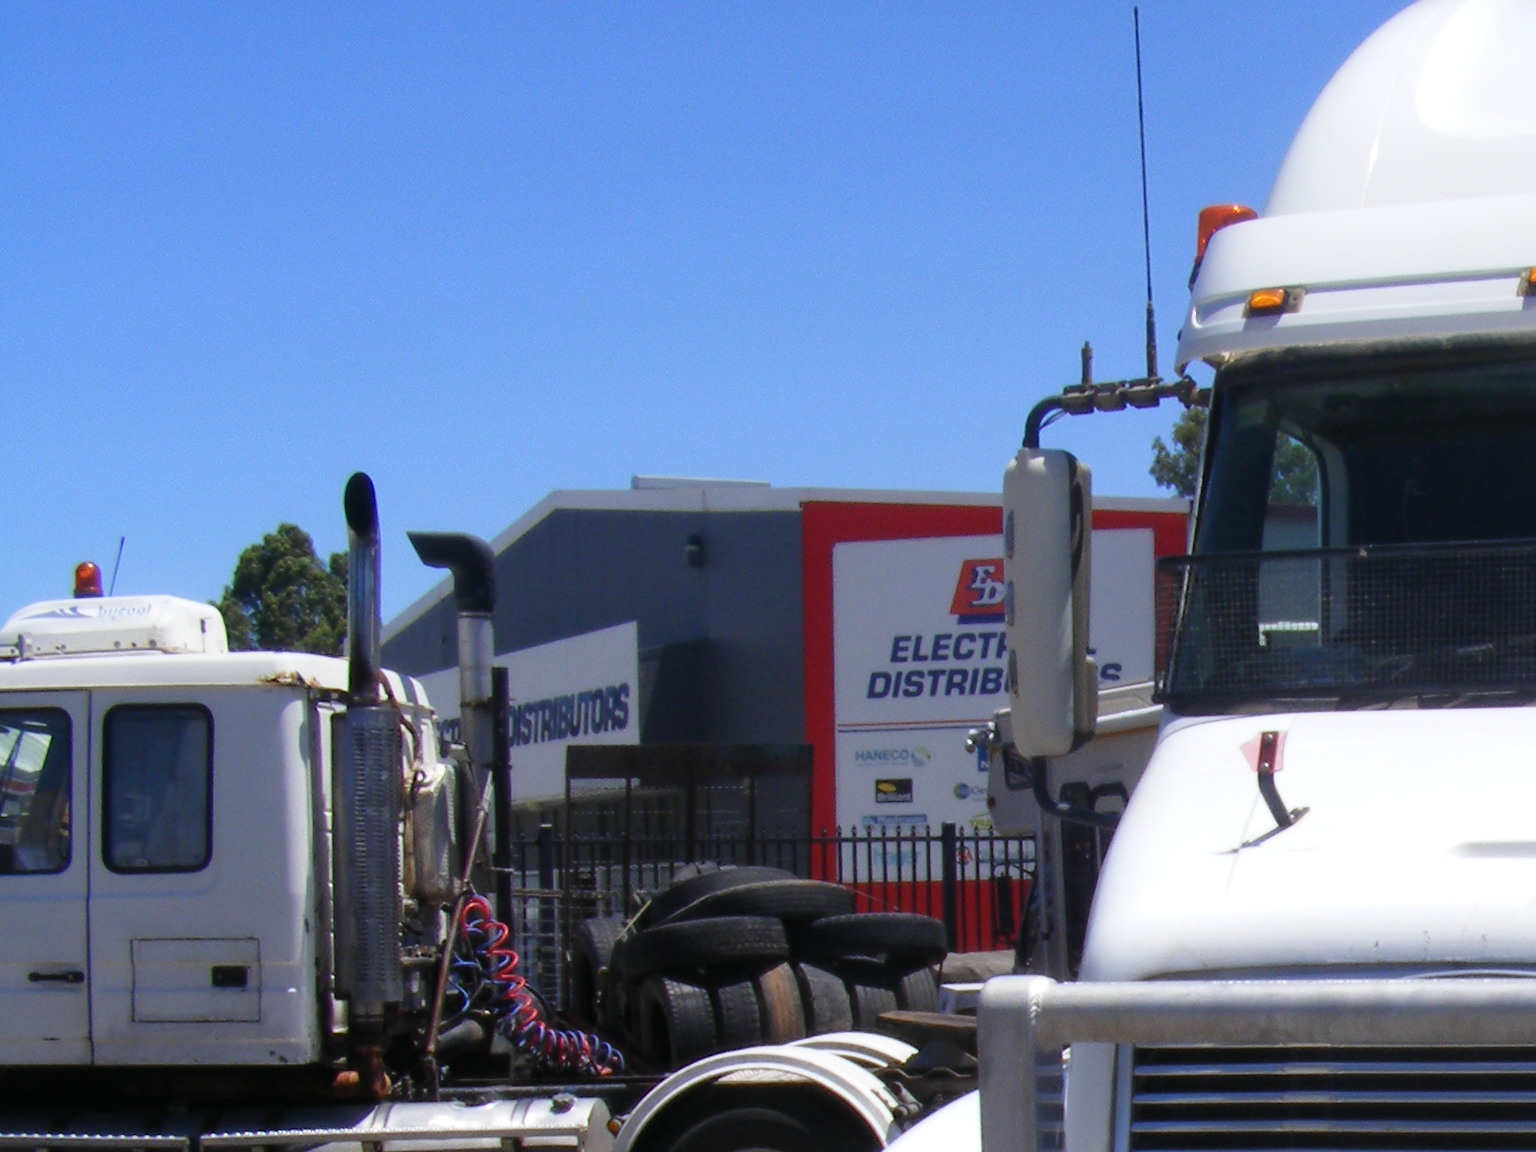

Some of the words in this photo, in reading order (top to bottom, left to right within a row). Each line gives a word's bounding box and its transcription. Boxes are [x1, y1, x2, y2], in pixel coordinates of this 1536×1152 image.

[98, 604, 152, 620] bycool
[508, 682, 629, 747] DISTRIBUTORS
[855, 749, 909, 762] HANECO
